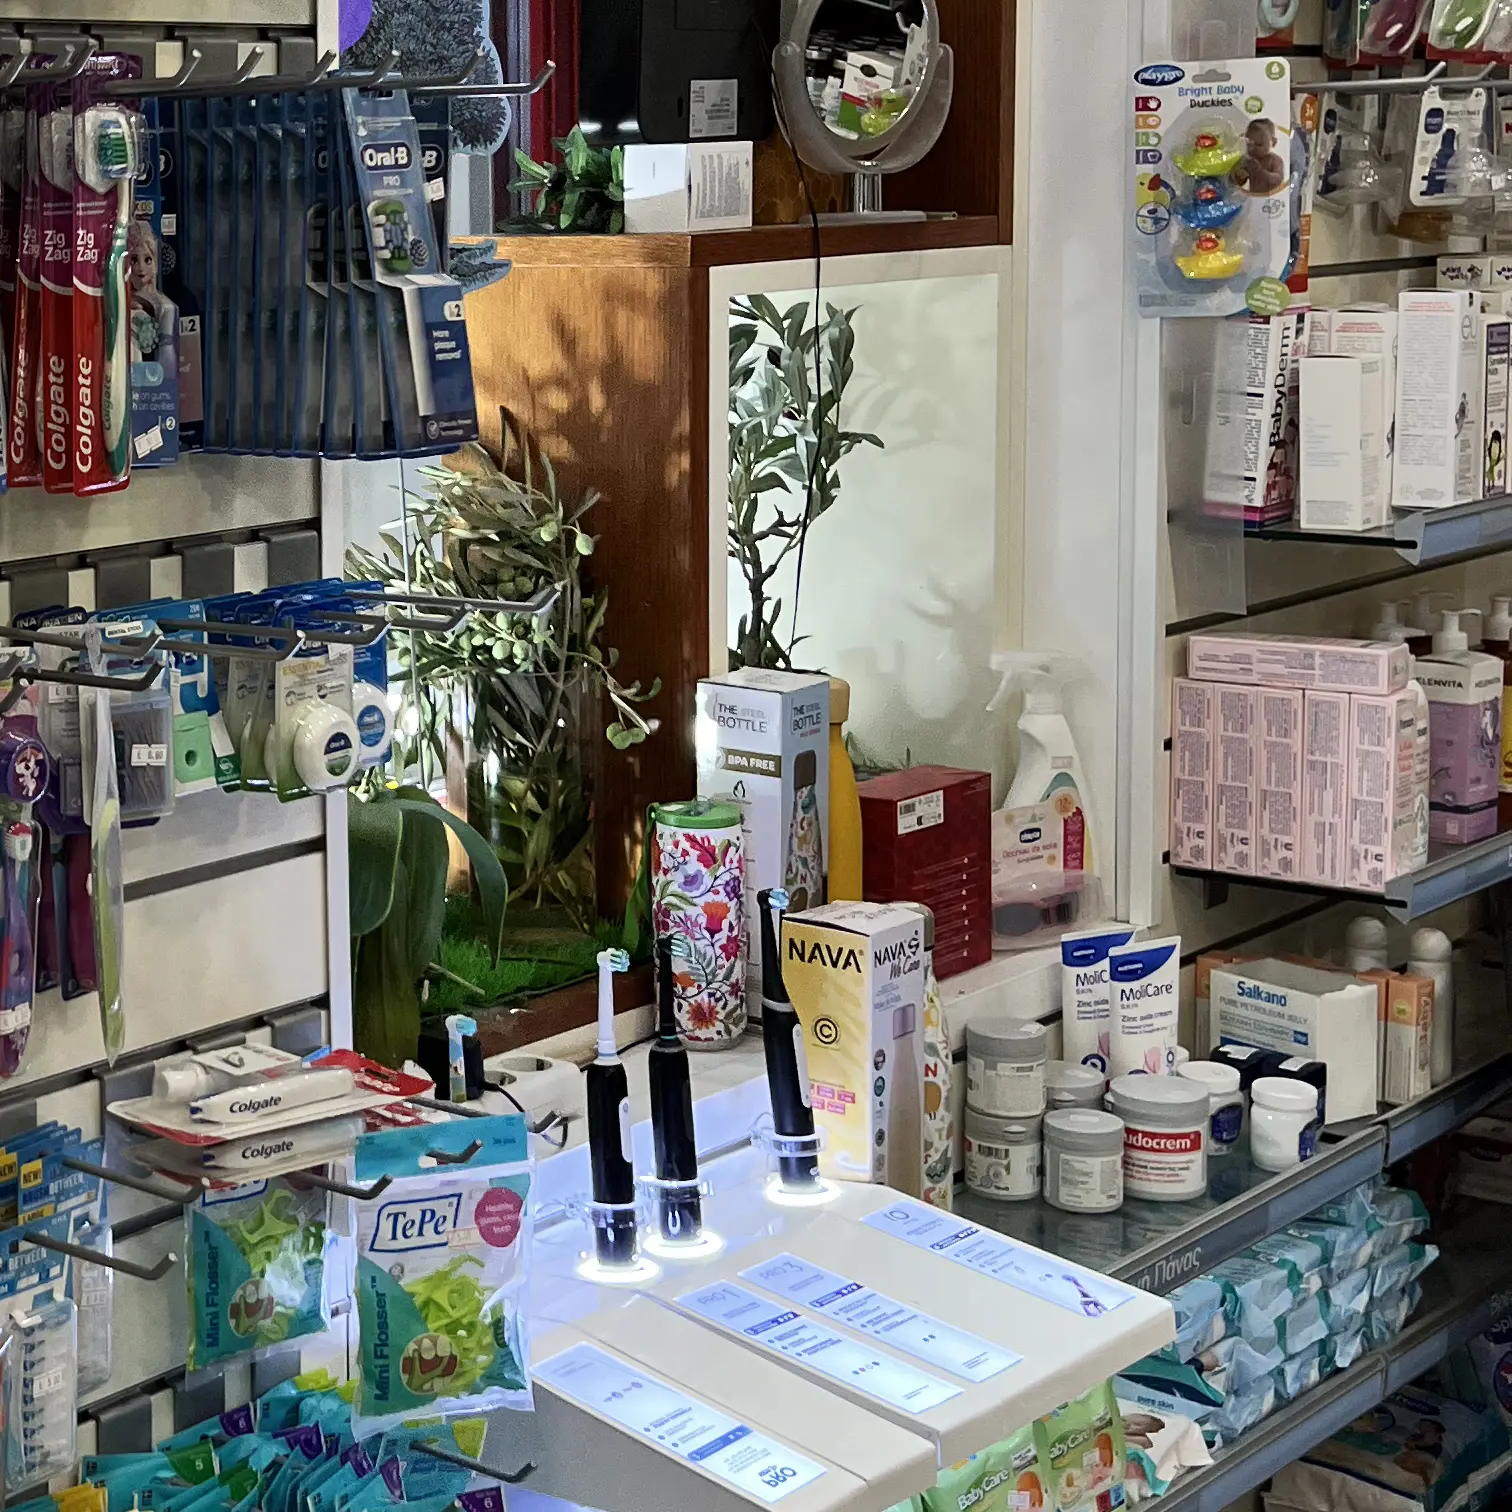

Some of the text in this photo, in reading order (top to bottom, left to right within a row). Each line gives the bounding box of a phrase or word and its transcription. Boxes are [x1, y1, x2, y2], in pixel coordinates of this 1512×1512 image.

[1178, 83, 1245, 99] Bright Baby
[1188, 97, 1233, 109] Duckies
[364, 148, 409, 168] Oral-B
[76, 230, 94, 250] Zig
[76, 244, 99, 263] Zag
[1268, 321, 1290, 448] BabyDerm
[42, 354, 66, 470] Colgate
[74, 357, 92, 474] Colgate
[717, 703, 737, 715] THE
[717, 716, 768, 733] BOTTLE
[727, 754, 776, 772] BPA FREE
[788, 937, 862, 973] NAVA
[1120, 981, 1172, 1002] MoliCare
[228, 1094, 283, 1117] Colgate
[241, 1138, 295, 1161] Colgate
[386, 1207, 449, 1242] TePe
[373, 1289, 388, 1401] Mini Flosser
[957, 1468, 1010, 1512] BabyCare
